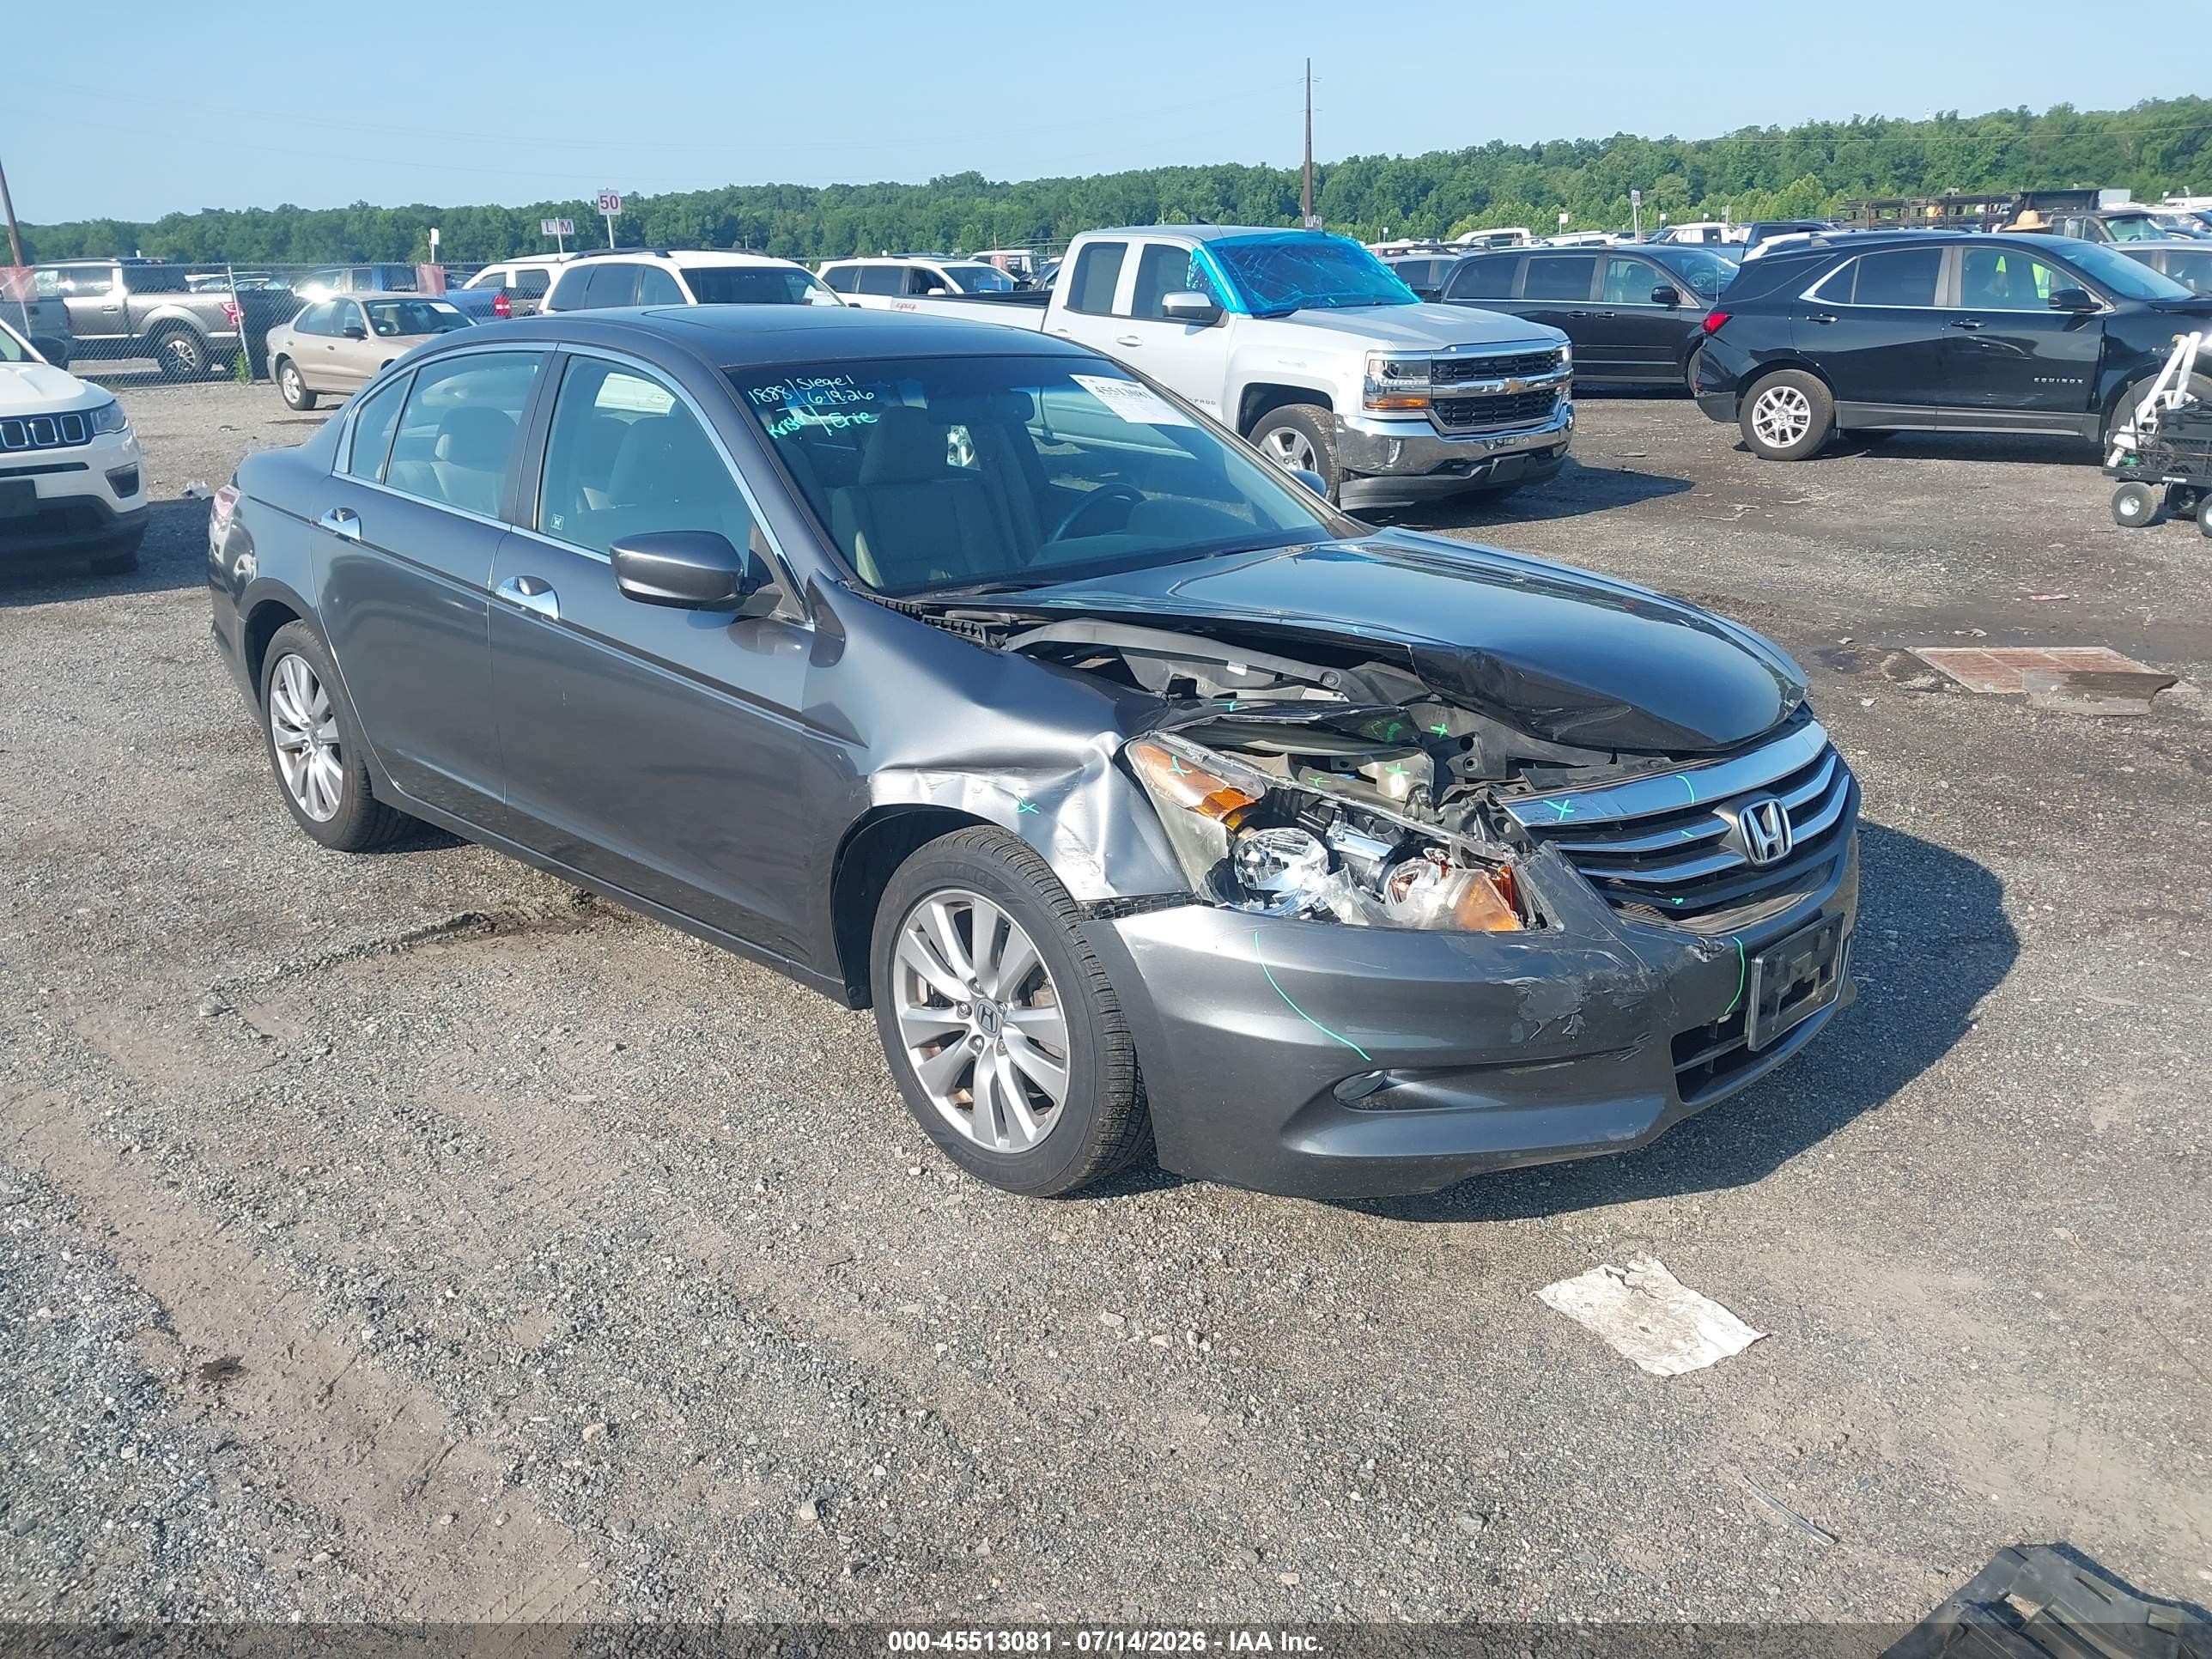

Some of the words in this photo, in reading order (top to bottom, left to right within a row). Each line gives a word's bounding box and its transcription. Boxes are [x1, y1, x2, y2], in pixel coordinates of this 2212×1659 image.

[599, 194, 619, 210] 50
[748, 386, 793, 404] 1888
[796, 374, 854, 391] Siegel
